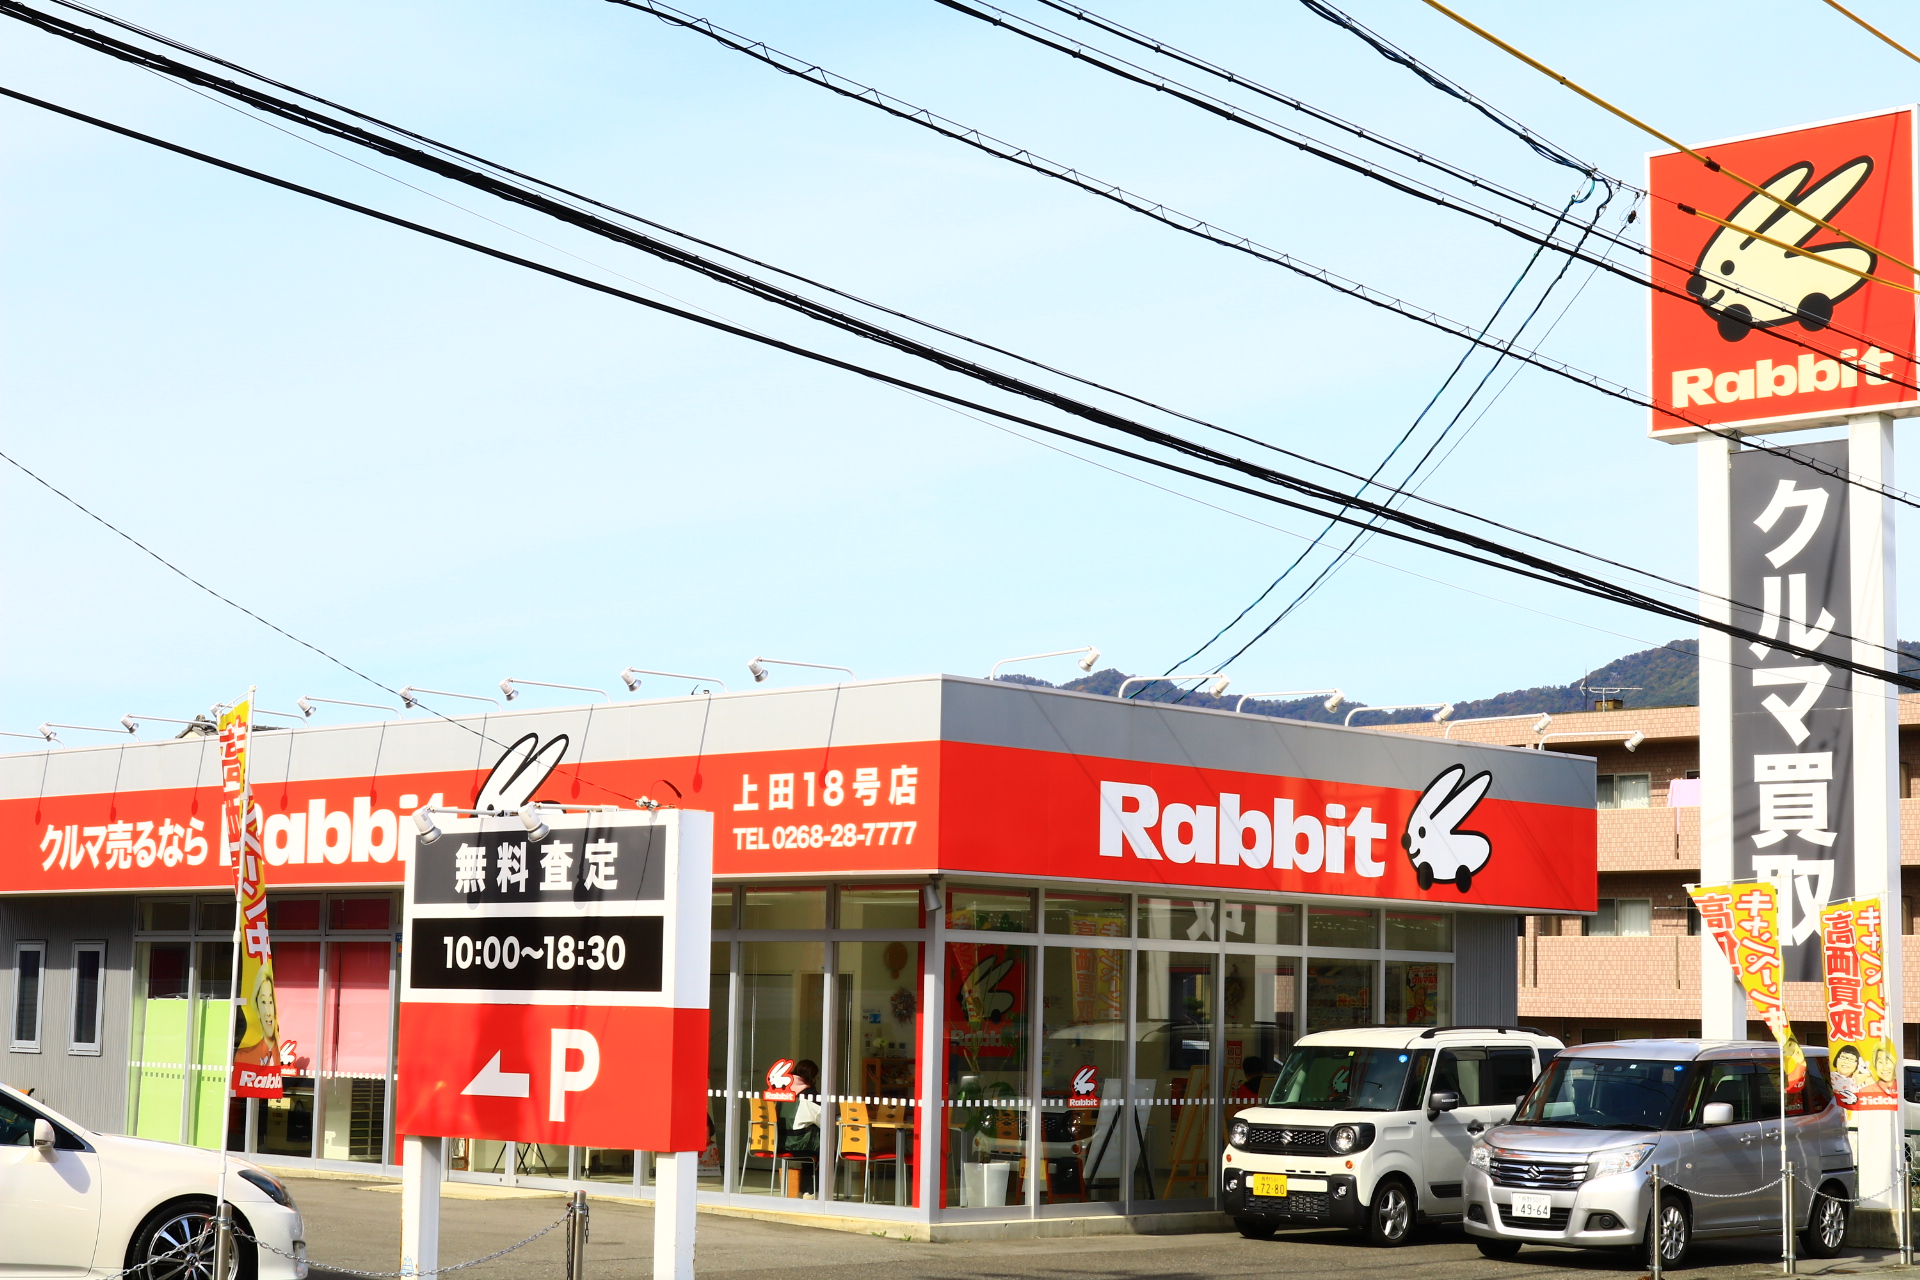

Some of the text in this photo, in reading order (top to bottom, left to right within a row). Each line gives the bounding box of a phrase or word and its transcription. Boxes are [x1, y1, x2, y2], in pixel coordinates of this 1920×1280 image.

[1672, 348, 1894, 408] Rabbit
[1750, 479, 1838, 946] クルマ買取
[733, 764, 918, 811] 上田18号店
[40, 817, 208, 872] クルマ売るなら
[733, 821, 917, 850] TEL 0268-28-7777
[1100, 780, 1387, 877] Rabbit
[454, 839, 618, 893] 無料査定
[951, 1030, 1018, 1047] Rabb
[549, 1028, 600, 1122] P
[765, 1092, 794, 1100] Rabbit
[1069, 1098, 1098, 1106] Rabbit
[1520, 1204, 1548, 1215] 49-64
